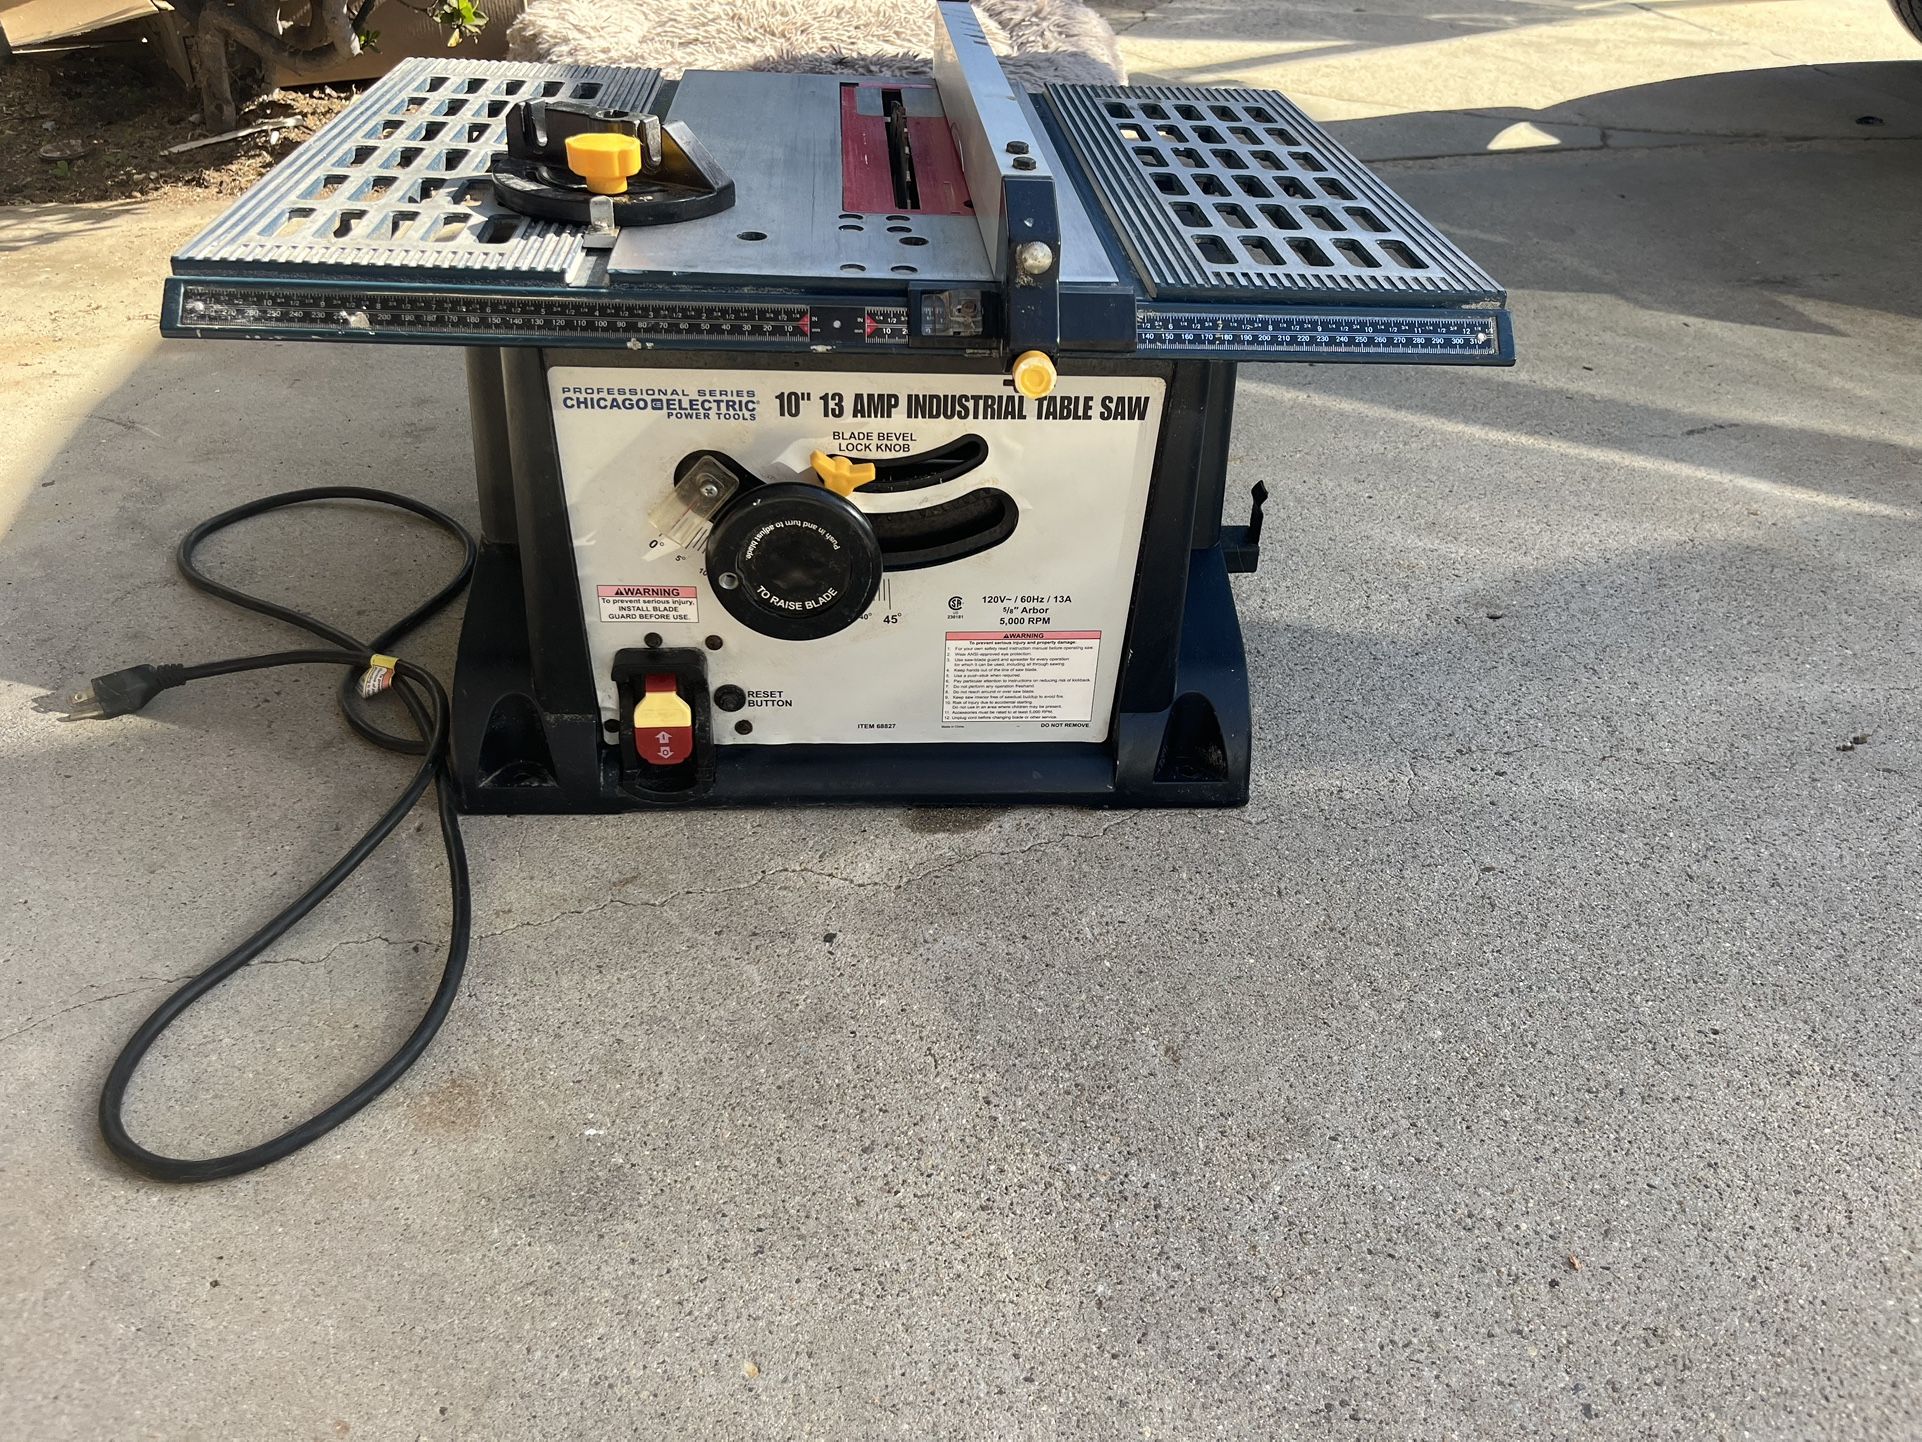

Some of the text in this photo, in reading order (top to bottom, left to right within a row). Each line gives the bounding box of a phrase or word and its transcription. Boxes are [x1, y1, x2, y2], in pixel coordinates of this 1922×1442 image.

[562, 387, 756, 398] PROFESSIONAL SERIES
[563, 396, 648, 410] CHICAGO
[776, 392, 1150, 421] 10" 13 AMP INDUSTRIAL TABLE SAW
[716, 412, 756, 420] TOOLS
[832, 431, 916, 442] BLADE BEVEL
[838, 442, 910, 452] LOCK KNOB
[802, 522, 818, 530] and
[754, 524, 774, 542] adjust
[818, 528, 826, 536] in
[825, 533, 840, 550] Push
[624, 588, 680, 596] WARNING
[757, 585, 838, 610] TO RAISE BLADE
[883, 612, 902, 624] 45°
[1000, 618, 1024, 626] 5,000
